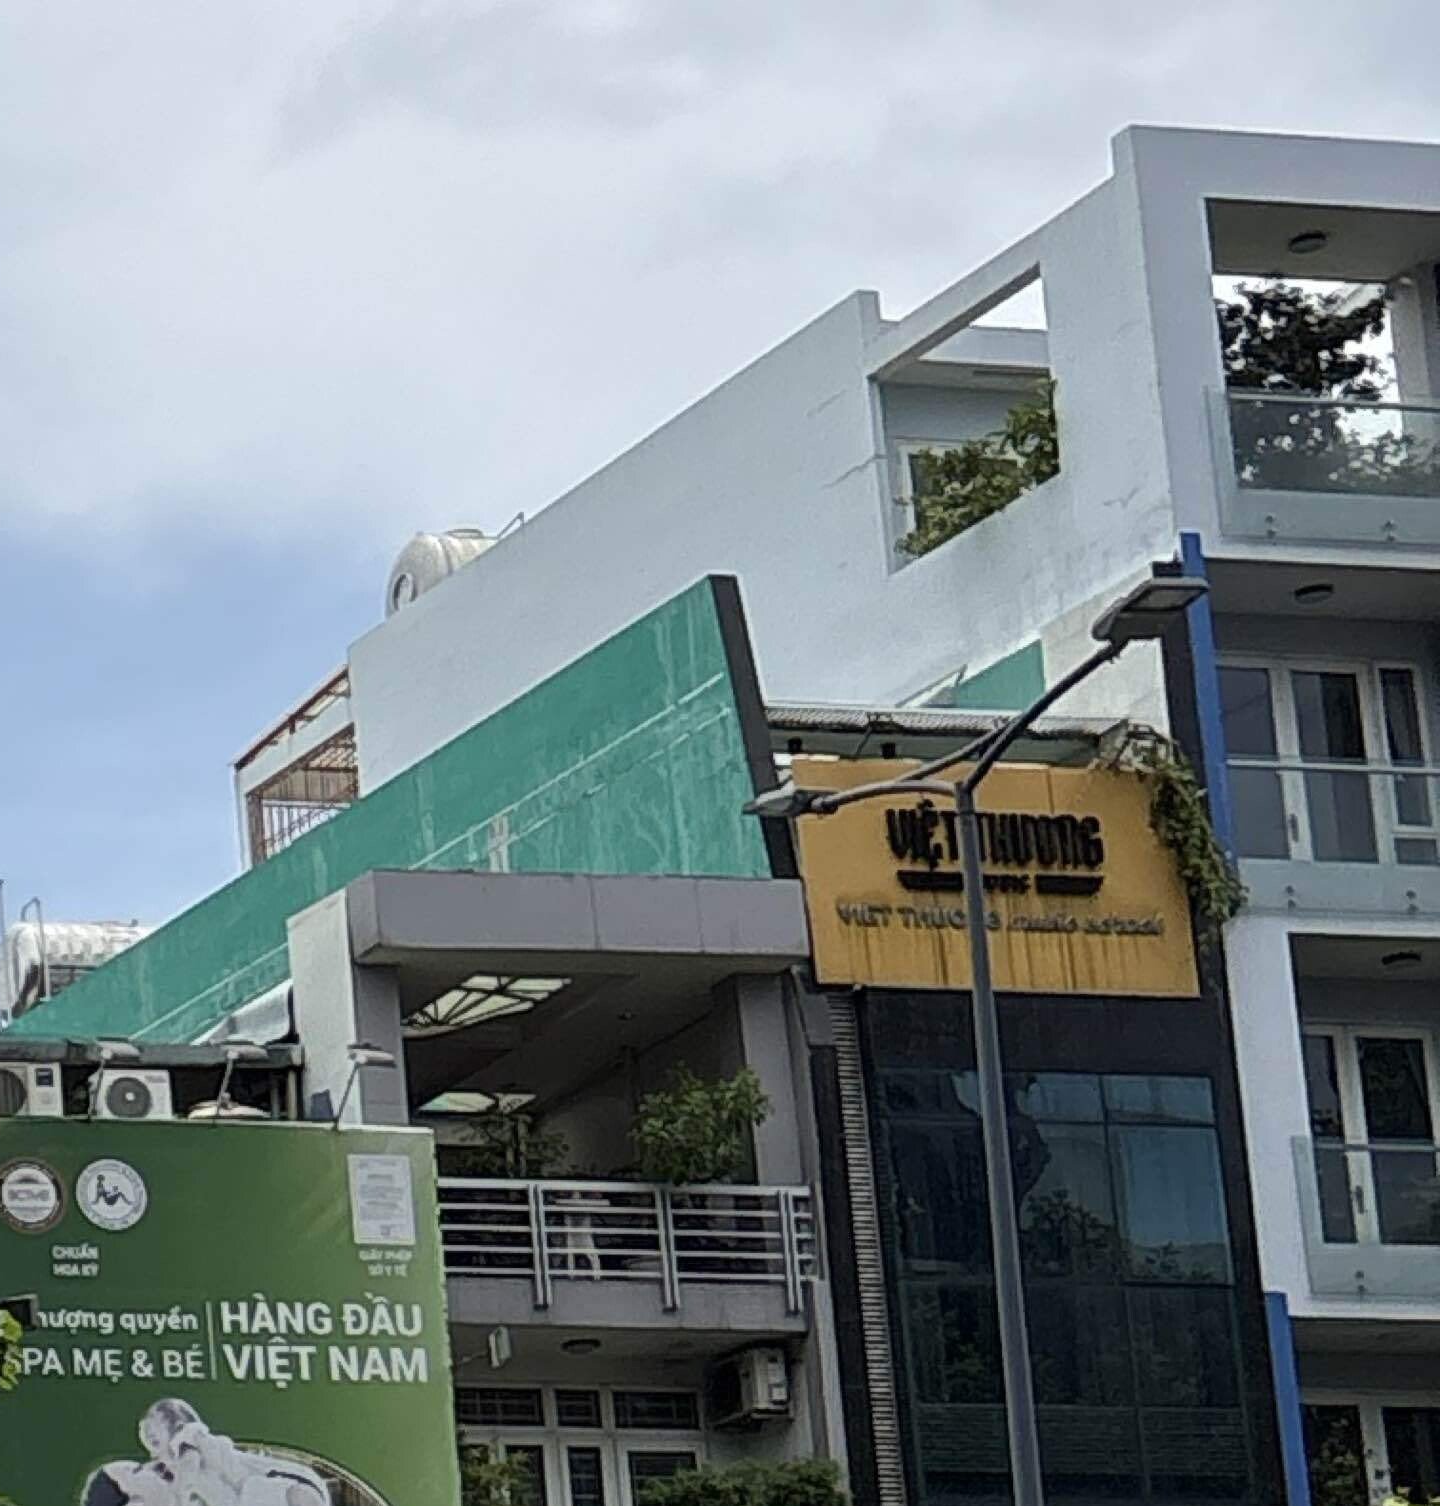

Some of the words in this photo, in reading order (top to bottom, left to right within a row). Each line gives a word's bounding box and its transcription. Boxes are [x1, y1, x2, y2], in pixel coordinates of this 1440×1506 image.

[119, 1303, 198, 1338] quyền
[220, 1292, 335, 1336] HÀNG
[342, 1291, 423, 1337] ĐẦU
[21, 1347, 66, 1376] PA
[71, 1347, 124, 1384] MẸ
[130, 1352, 155, 1379] &
[162, 1343, 206, 1380] BÉ
[221, 1342, 318, 1389] VIỆT
[328, 1347, 428, 1383] NAM
